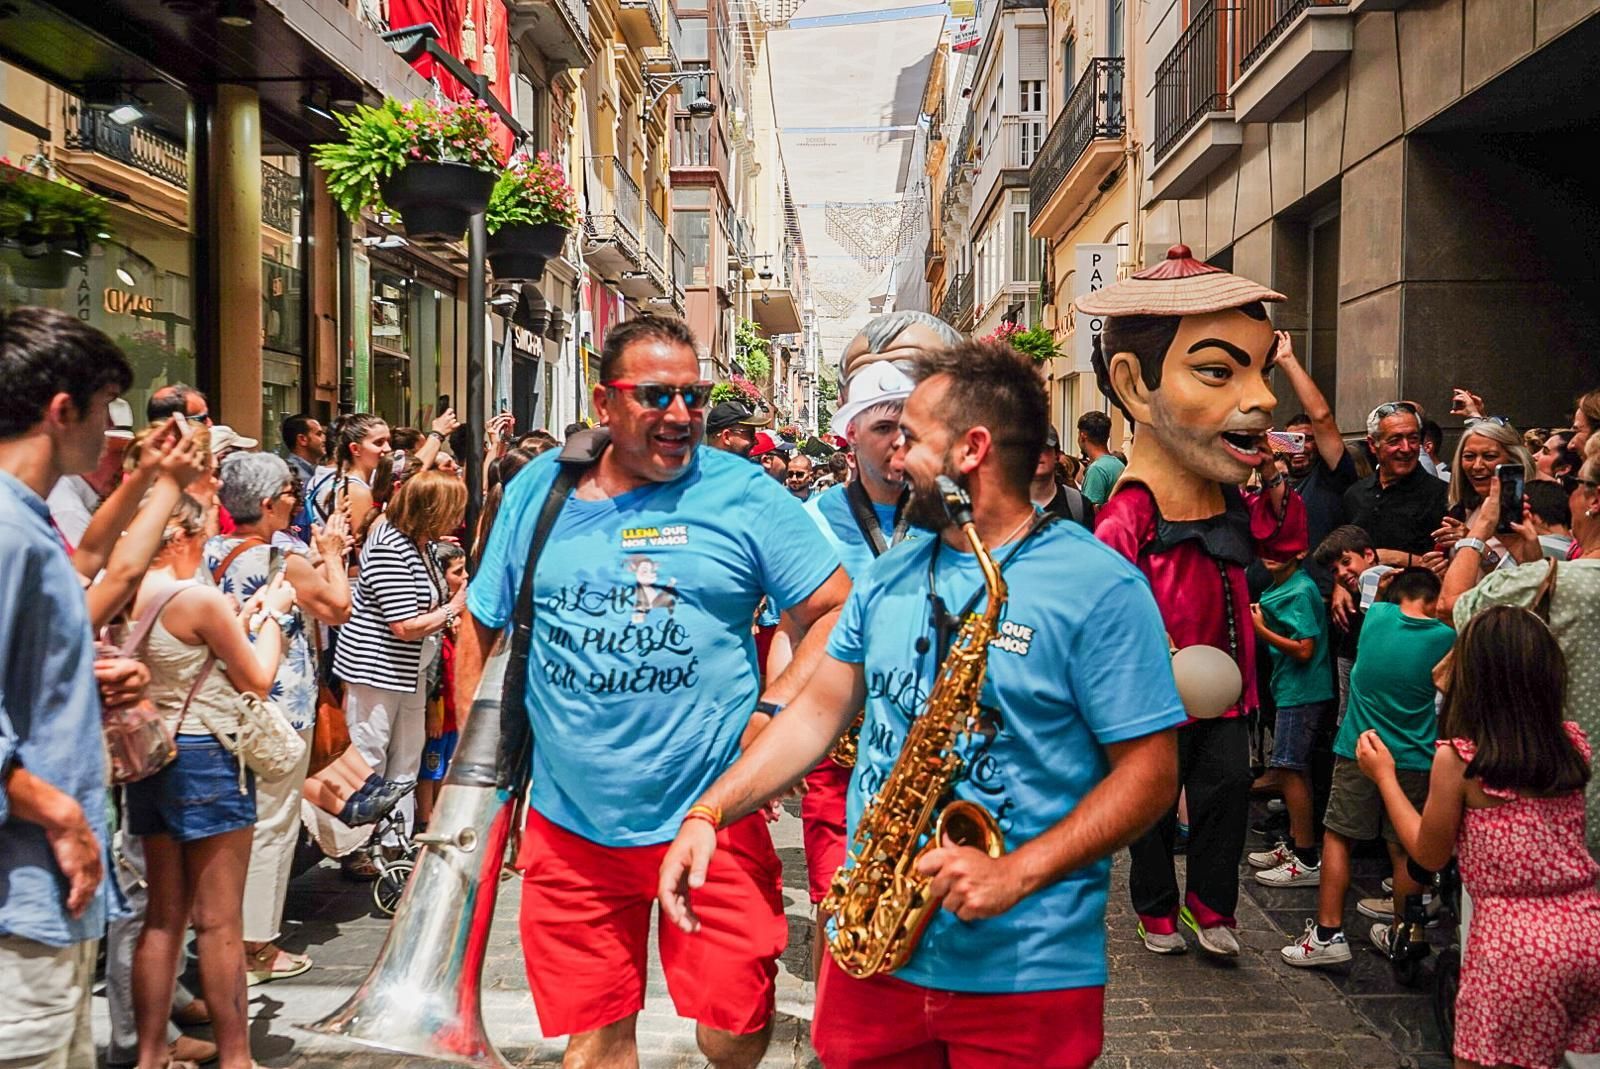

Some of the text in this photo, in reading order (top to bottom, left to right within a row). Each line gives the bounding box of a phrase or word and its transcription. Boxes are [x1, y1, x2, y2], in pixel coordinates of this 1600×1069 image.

[622, 525, 689, 539] LLENA QUE
[621, 535, 689, 548] NOS VAMOS
[1001, 620, 1035, 642] QUE
[989, 635, 1030, 656] AMOS
